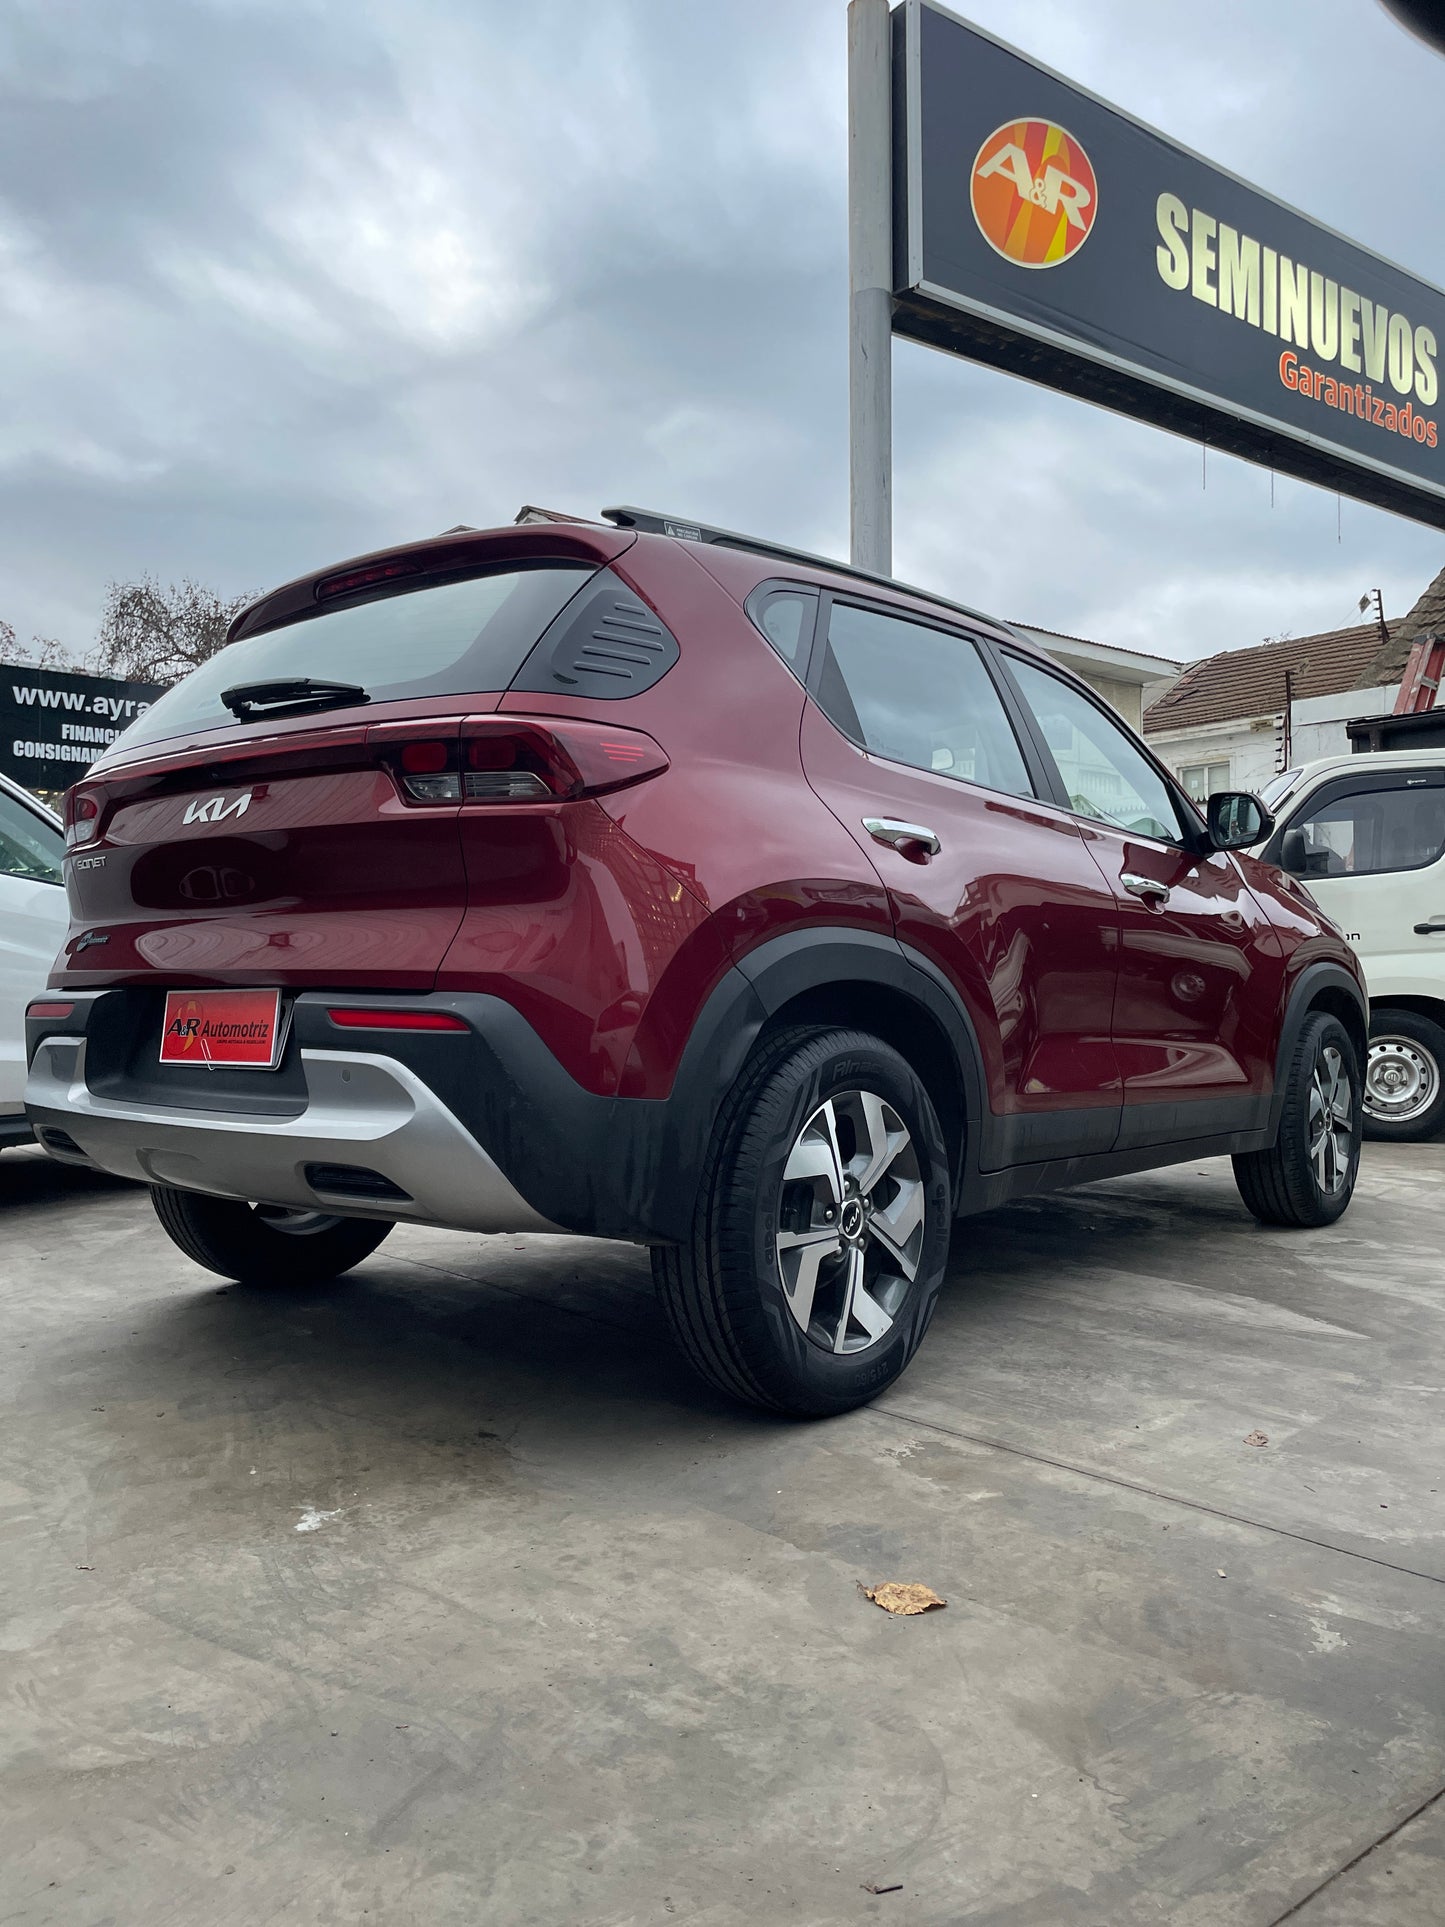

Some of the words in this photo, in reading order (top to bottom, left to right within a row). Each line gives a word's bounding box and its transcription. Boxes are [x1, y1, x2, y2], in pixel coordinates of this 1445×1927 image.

[976, 142, 1091, 232] A&R
[1156, 192, 1438, 406] SEMINUEVOS
[1279, 350, 1438, 448] Garantizados
[61, 723, 125, 745] FINANCI
[182, 793, 252, 825] KIA
[77, 856, 106, 870] SONET
[166, 1018, 201, 1037] A&R
[200, 1019, 269, 1038] Automotriz
